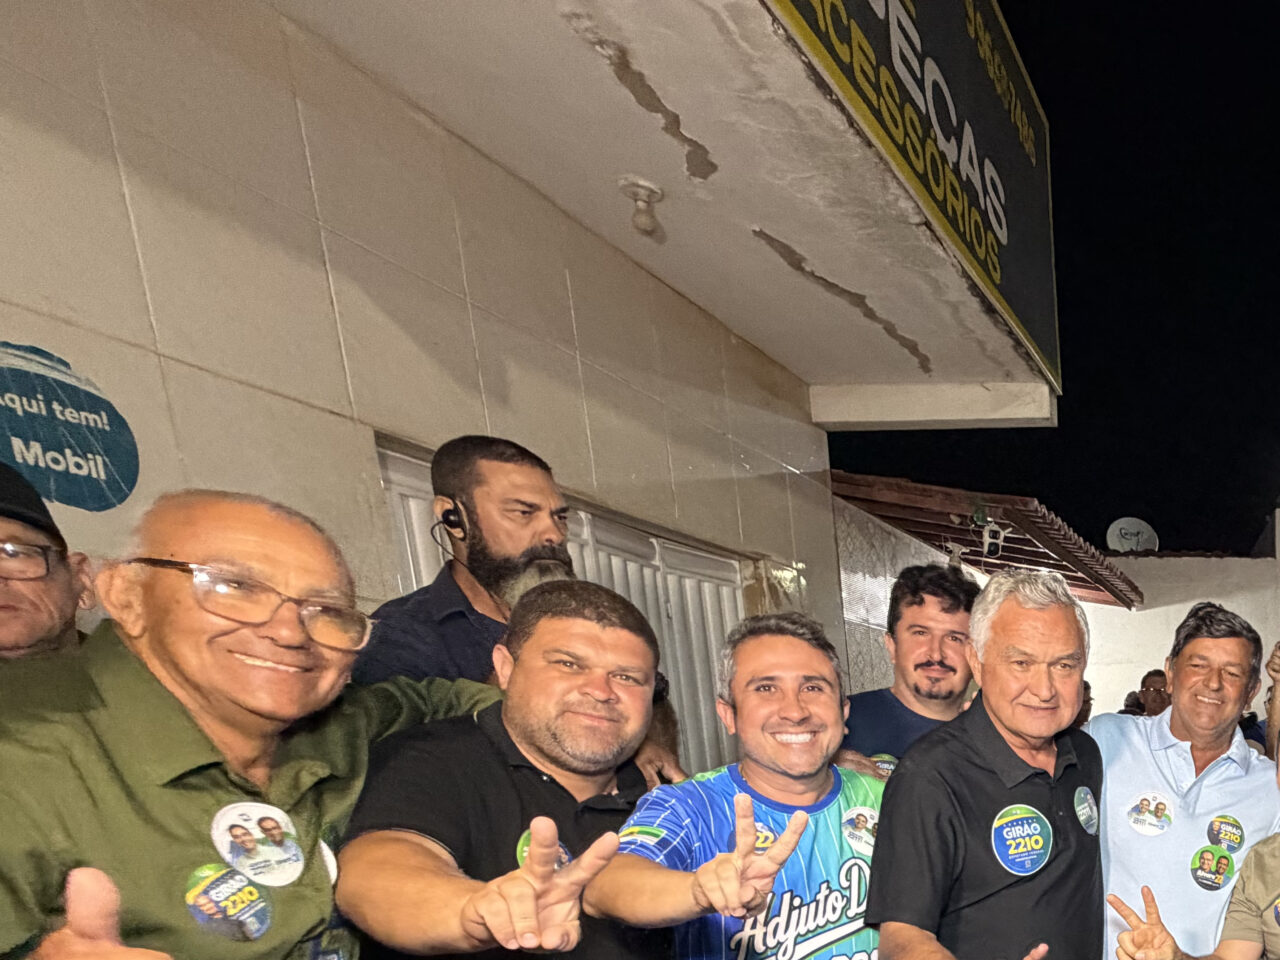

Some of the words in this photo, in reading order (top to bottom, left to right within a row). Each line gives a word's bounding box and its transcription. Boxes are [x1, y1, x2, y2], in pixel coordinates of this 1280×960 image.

[868, 0, 1008, 246] EÇAS
[0, 391, 47, 416] qui
[52, 400, 110, 431] tem!
[10, 436, 107, 480] Mobil
[1003, 821, 1041, 839] GIRÃO
[1006, 834, 1044, 855] 2210
[1219, 830, 1241, 843] 2210
